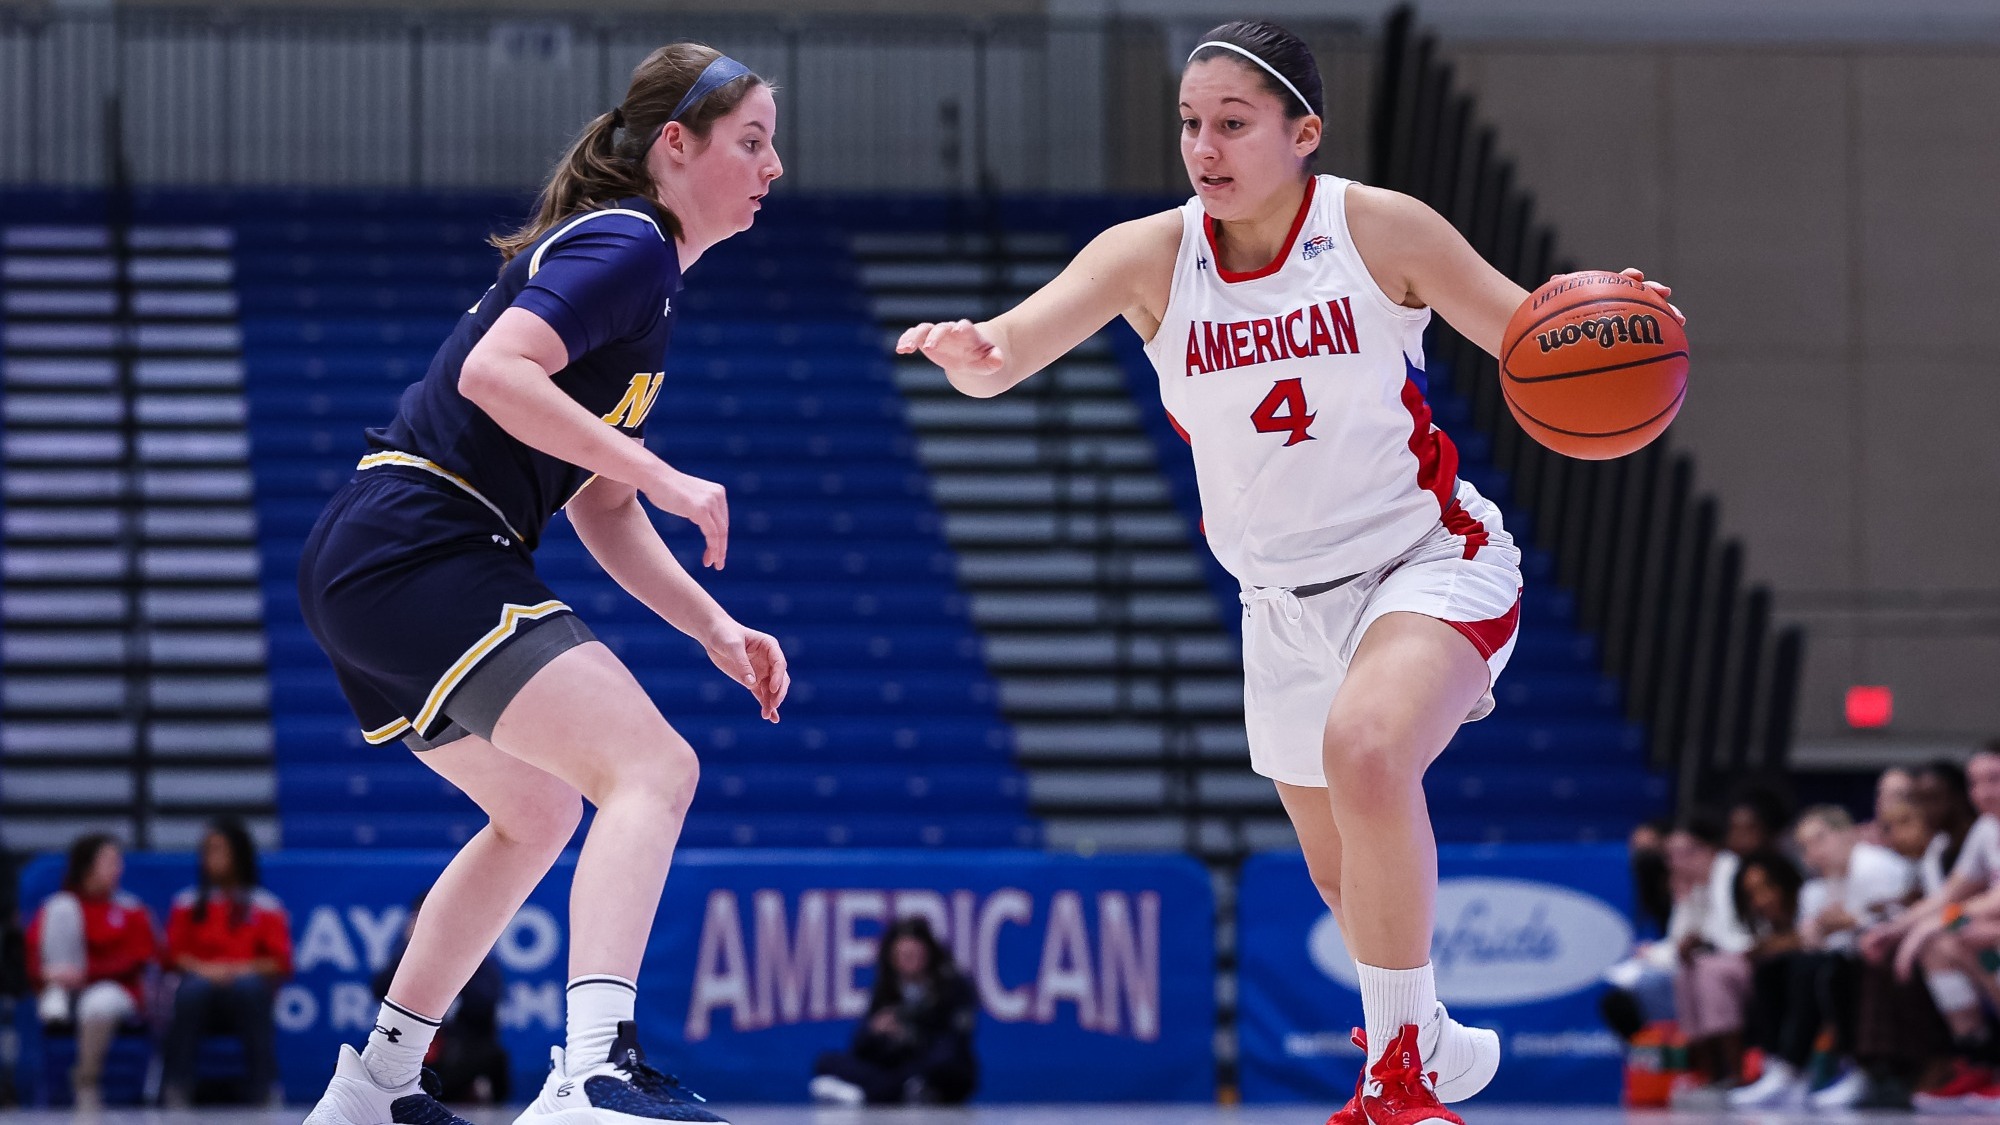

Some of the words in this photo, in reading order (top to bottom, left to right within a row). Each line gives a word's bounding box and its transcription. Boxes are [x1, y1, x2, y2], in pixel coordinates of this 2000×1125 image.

[1185, 295, 1361, 377] AMERICAN
[1536, 313, 1665, 355] Wilson
[1249, 376, 1319, 447] 4
[296, 905, 405, 970] AY
[496, 905, 561, 971] O
[1402, 1051, 1410, 1069] CUR
